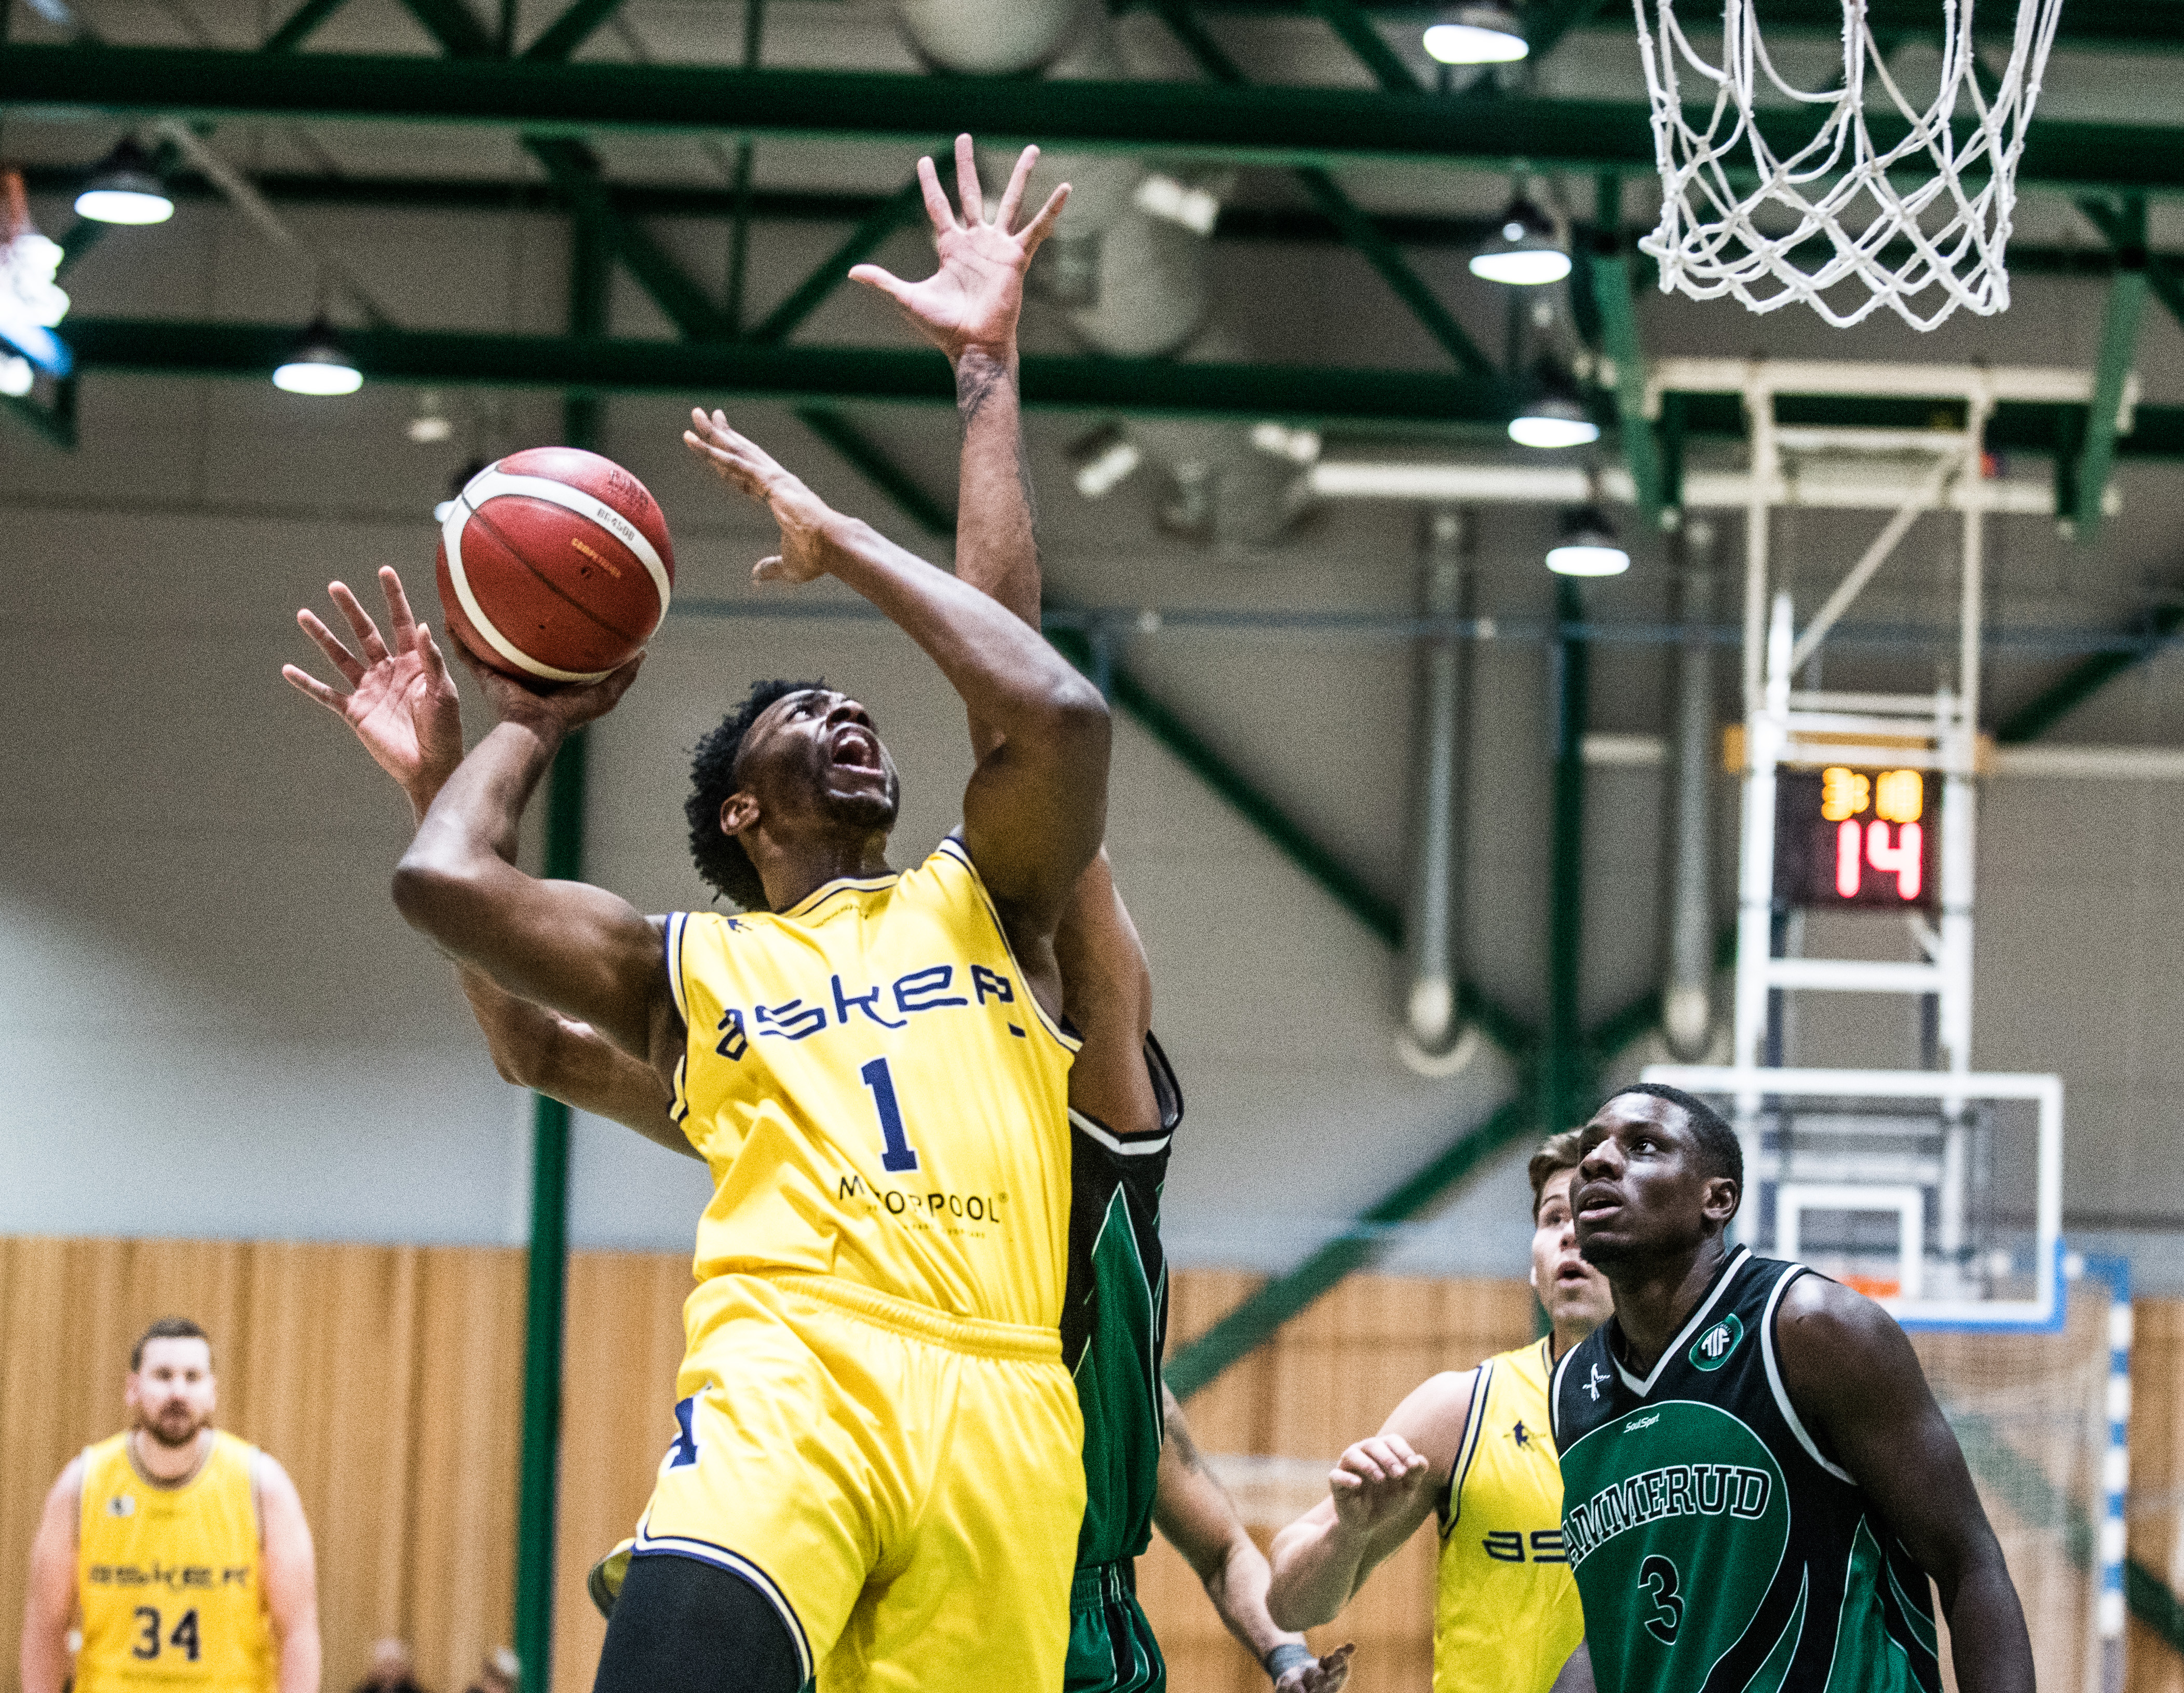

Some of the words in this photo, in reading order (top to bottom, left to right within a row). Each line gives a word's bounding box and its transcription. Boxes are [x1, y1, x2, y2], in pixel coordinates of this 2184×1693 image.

[1836, 818, 1923, 900] 14
[861, 1057, 918, 1172] 1
[132, 1605, 202, 1662] 34
[1638, 1554, 1685, 1645] 3
